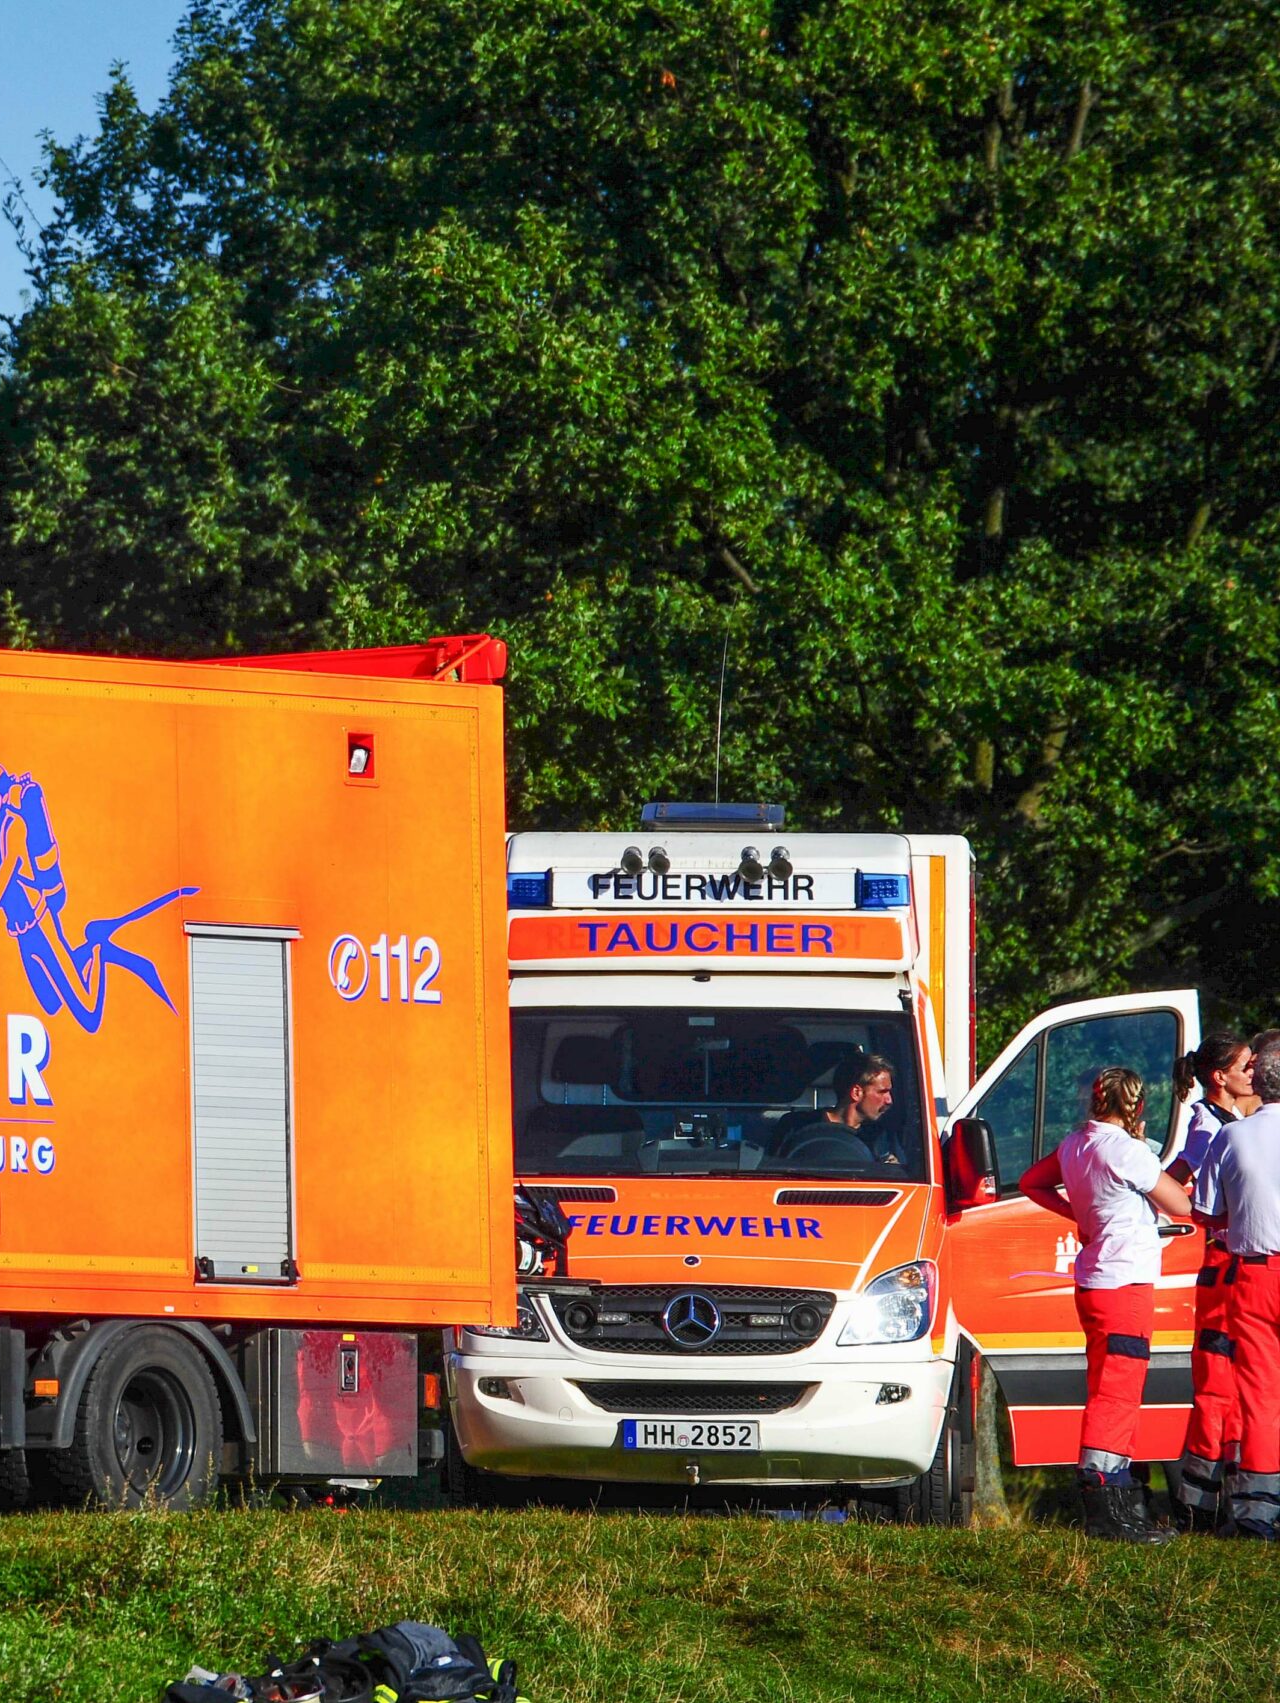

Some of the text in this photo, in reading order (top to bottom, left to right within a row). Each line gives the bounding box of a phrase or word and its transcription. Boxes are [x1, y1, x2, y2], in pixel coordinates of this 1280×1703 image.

[593, 874, 815, 901] FEUERWEHR
[577, 921, 834, 954] TAUCHER
[370, 933, 442, 1004] 112
[643, 1424, 675, 1445] HH
[691, 1425, 752, 1446] 2852
